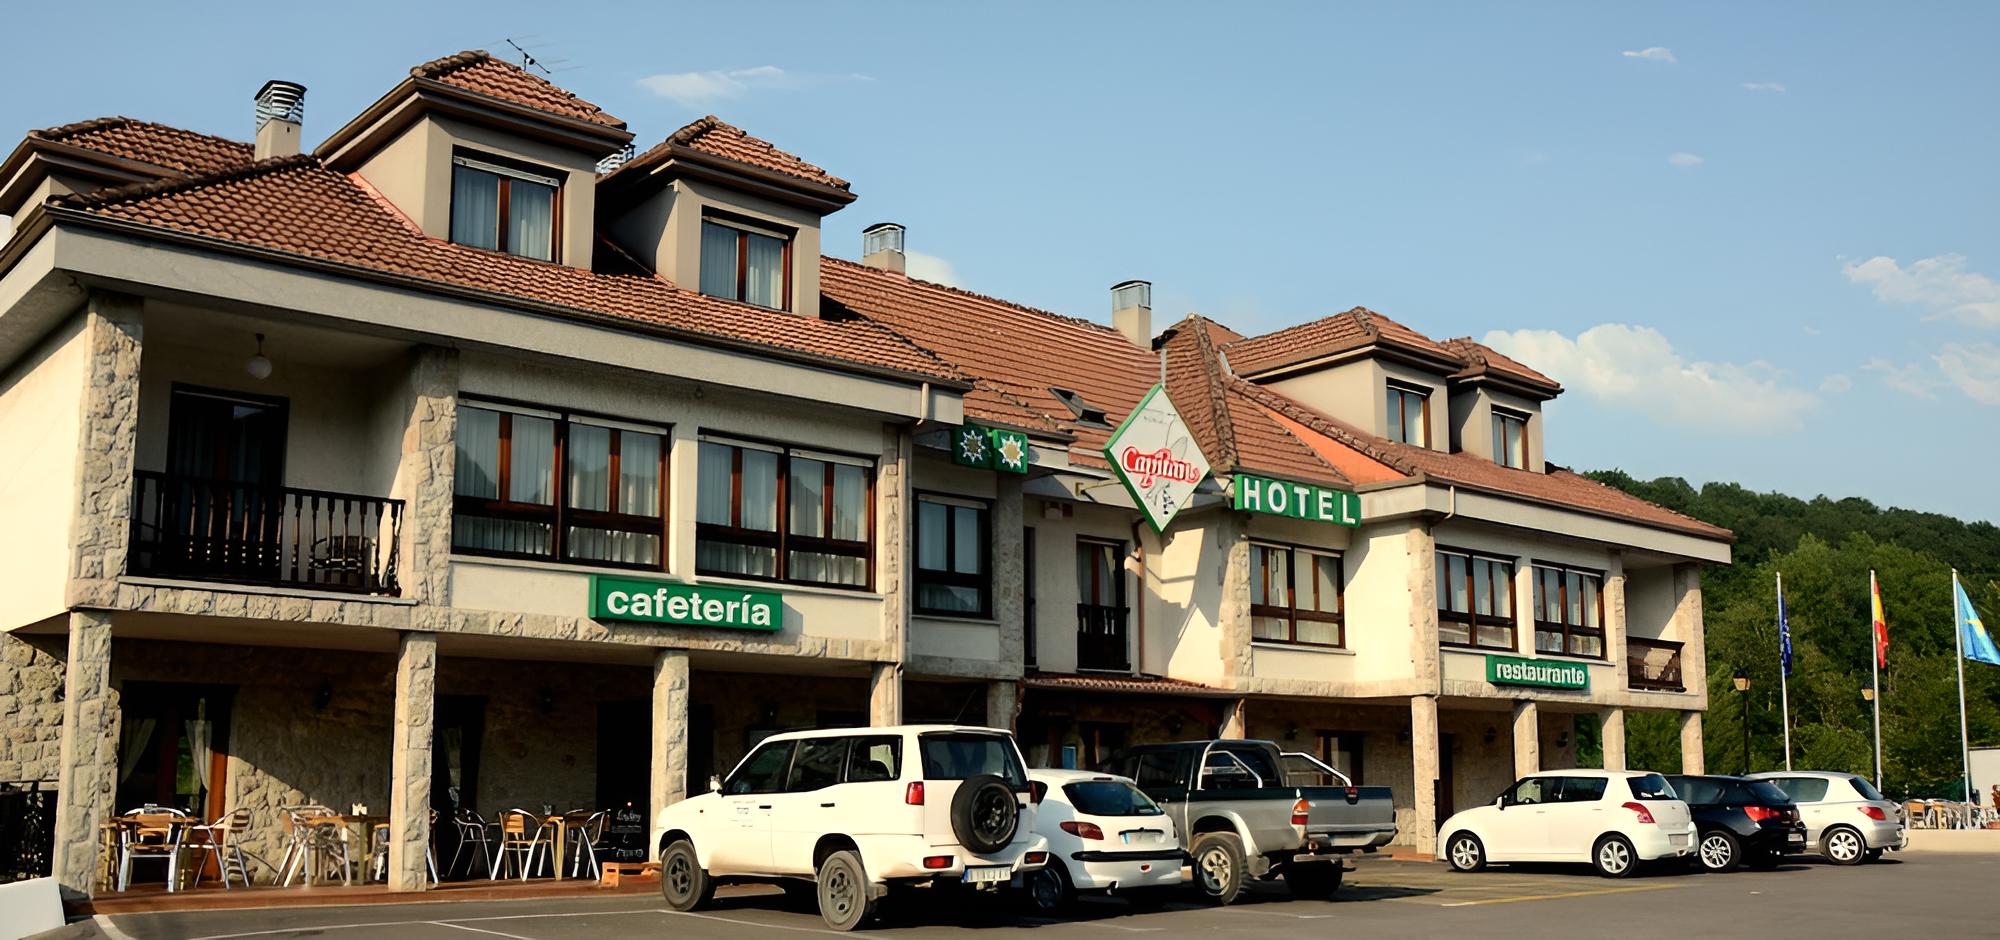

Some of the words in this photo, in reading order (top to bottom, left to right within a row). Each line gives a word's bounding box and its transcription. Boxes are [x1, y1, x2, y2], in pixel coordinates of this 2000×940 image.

[1243, 478, 1356, 524] HOTEL
[606, 588, 771, 626] cafetería
[1496, 662, 1586, 685] restaurante
